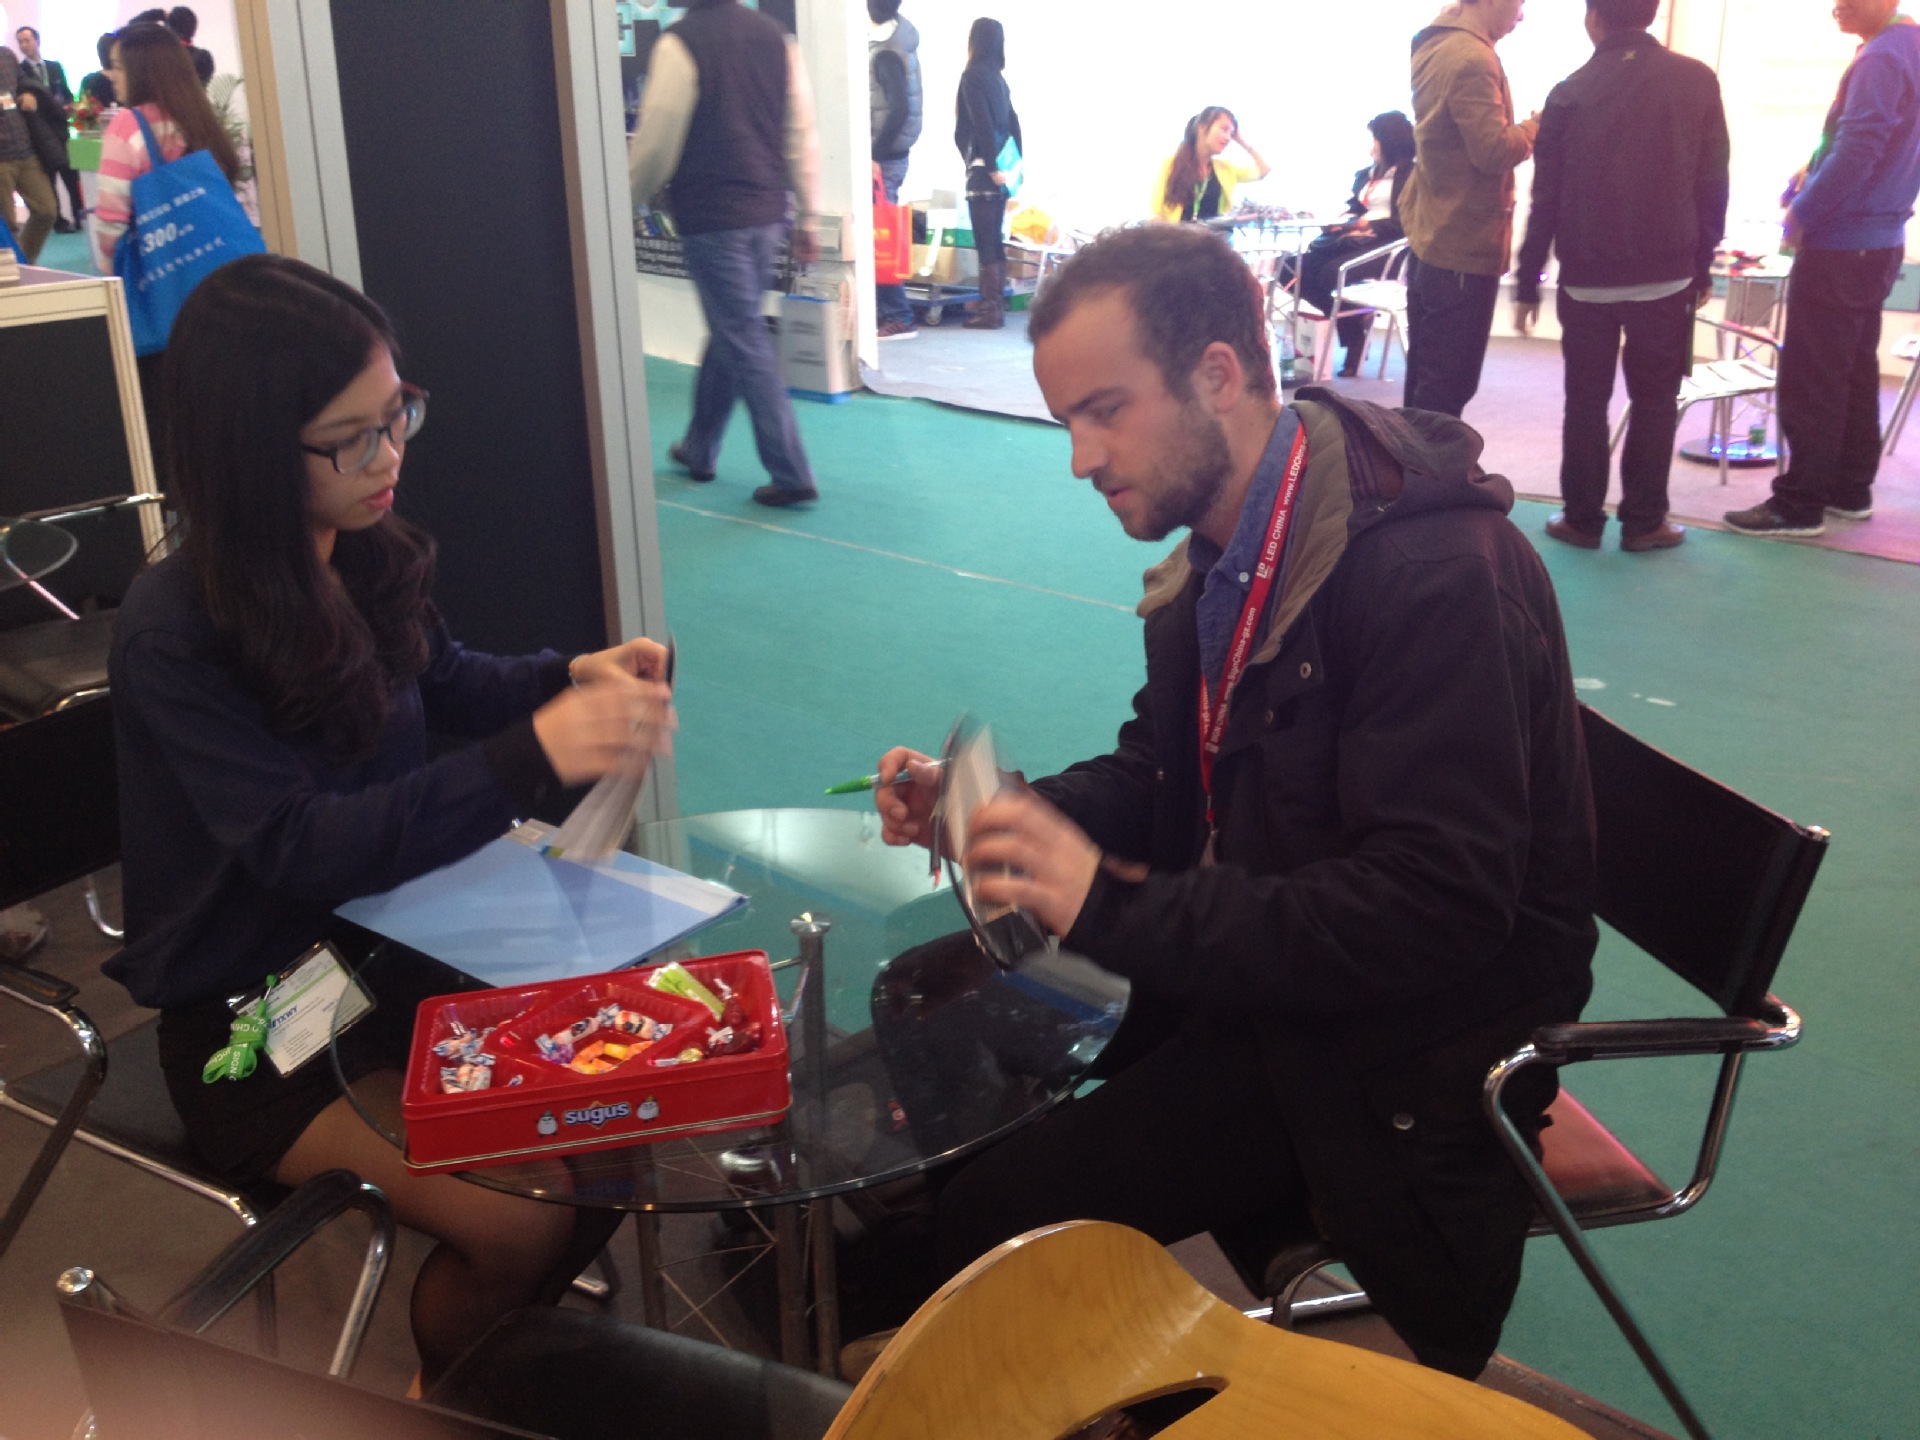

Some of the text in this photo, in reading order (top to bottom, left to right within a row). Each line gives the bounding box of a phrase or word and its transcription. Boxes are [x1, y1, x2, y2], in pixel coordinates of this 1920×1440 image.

[143, 222, 177, 253] 300
[1265, 541, 1278, 562] LED
[1272, 509, 1288, 540] CHINA
[229, 1051, 241, 1074] SIGN
[564, 1102, 630, 1125] sugus
